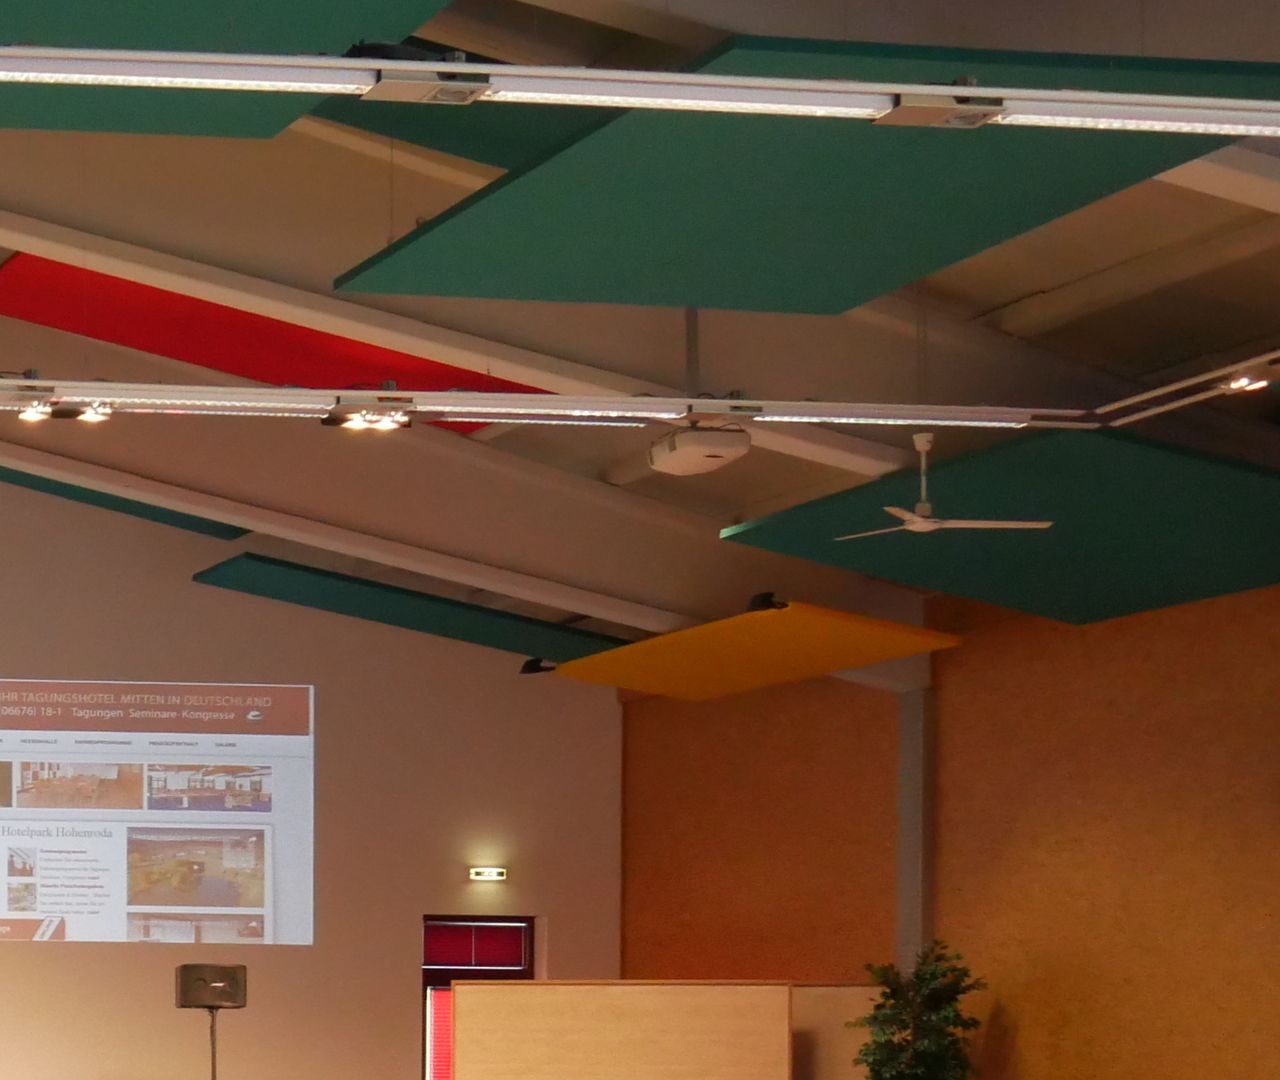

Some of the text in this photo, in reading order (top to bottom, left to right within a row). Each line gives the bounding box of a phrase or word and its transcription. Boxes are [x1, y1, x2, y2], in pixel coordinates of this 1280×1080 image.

[22, 692, 116, 705] TAGUNGSHOTEL
[120, 694, 165, 705] MITTEN
[167, 695, 181, 706] IN
[183, 696, 272, 708] DEUTSCHLAND
[40, 706, 62, 717] 18-1
[72, 707, 124, 719] Tagungen
[128, 708, 177, 719] Seminare
[181, 709, 236, 721] Kongresse
[1, 826, 54, 840] Hotelpark
[56, 827, 114, 839] Hohenroda
